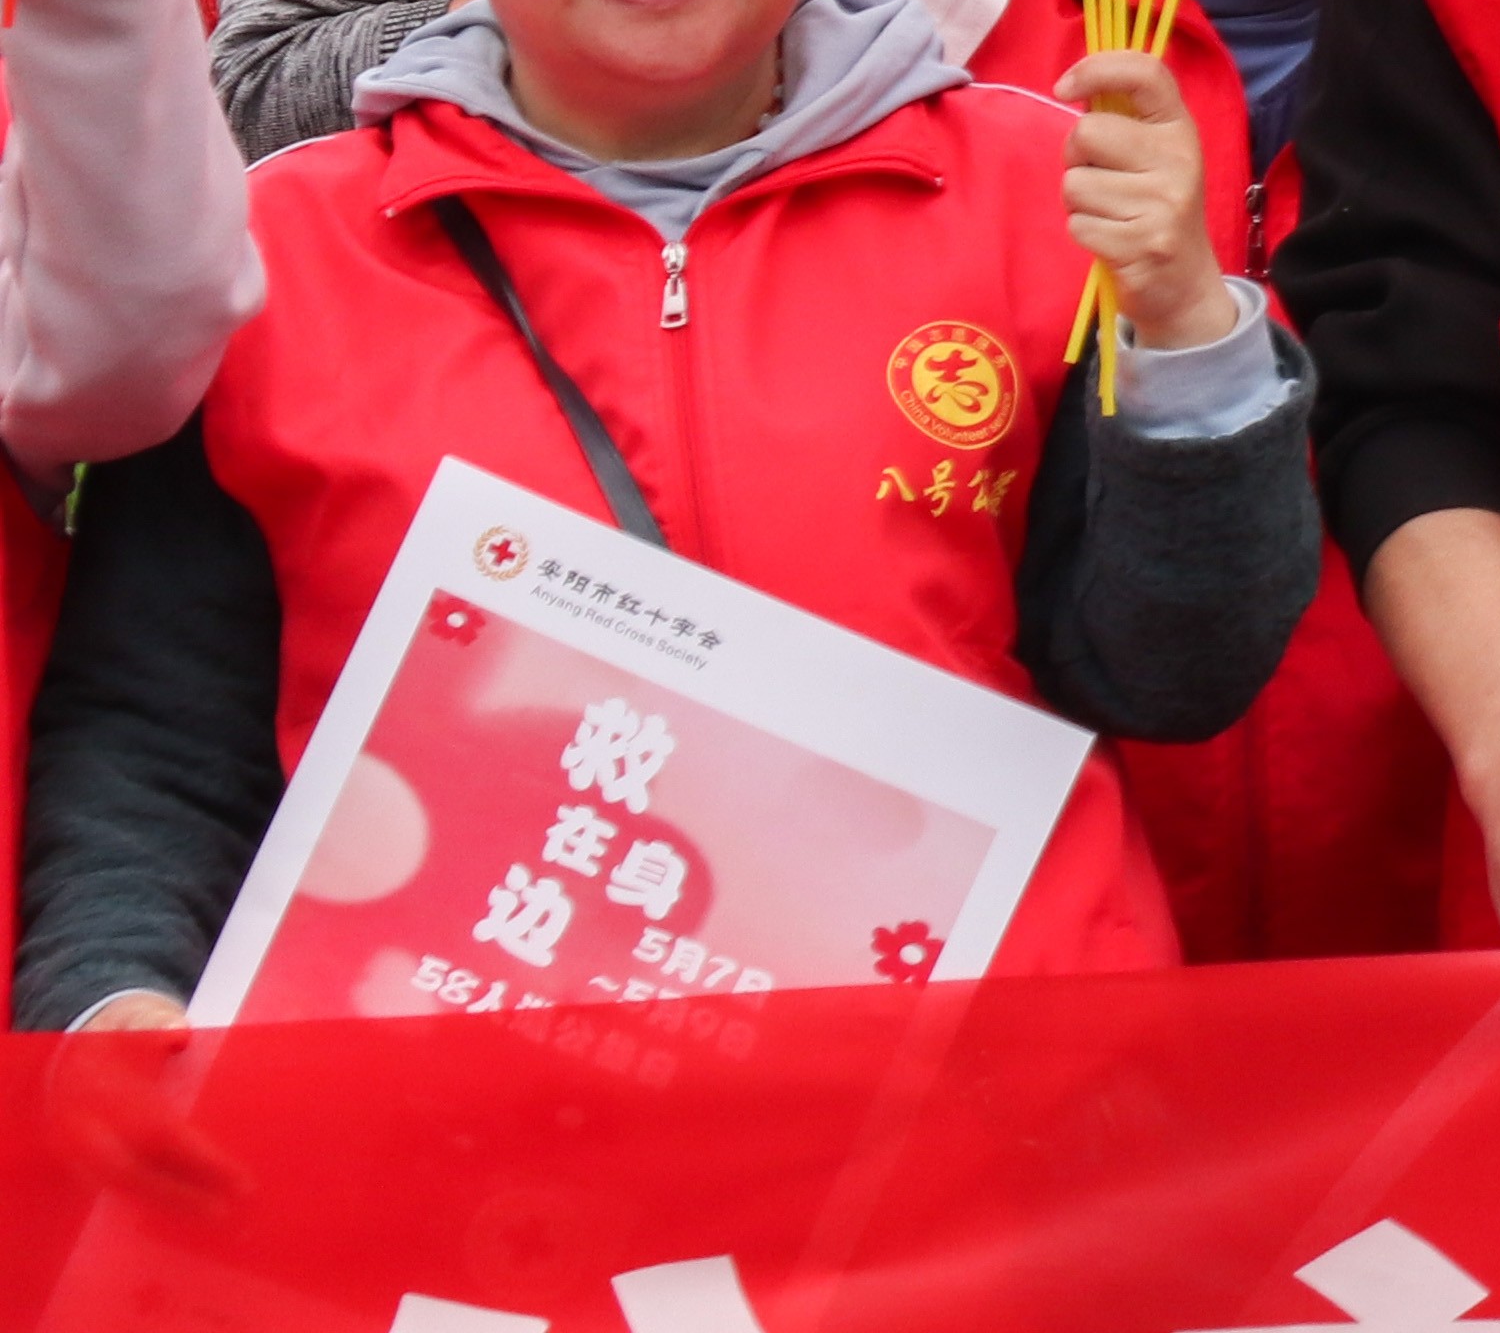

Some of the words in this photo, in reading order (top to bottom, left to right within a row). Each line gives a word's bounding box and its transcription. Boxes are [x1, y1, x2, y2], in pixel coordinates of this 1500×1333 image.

[530, 585, 582, 618] Anyang
[584, 608, 613, 629] Red
[614, 621, 654, 647] Cross
[655, 639, 709, 671] Society
[537, 559, 722, 650] 安阳市红十字会
[560, 697, 676, 814] 救
[542, 804, 687, 920] 在身
[472, 863, 572, 967] 边
